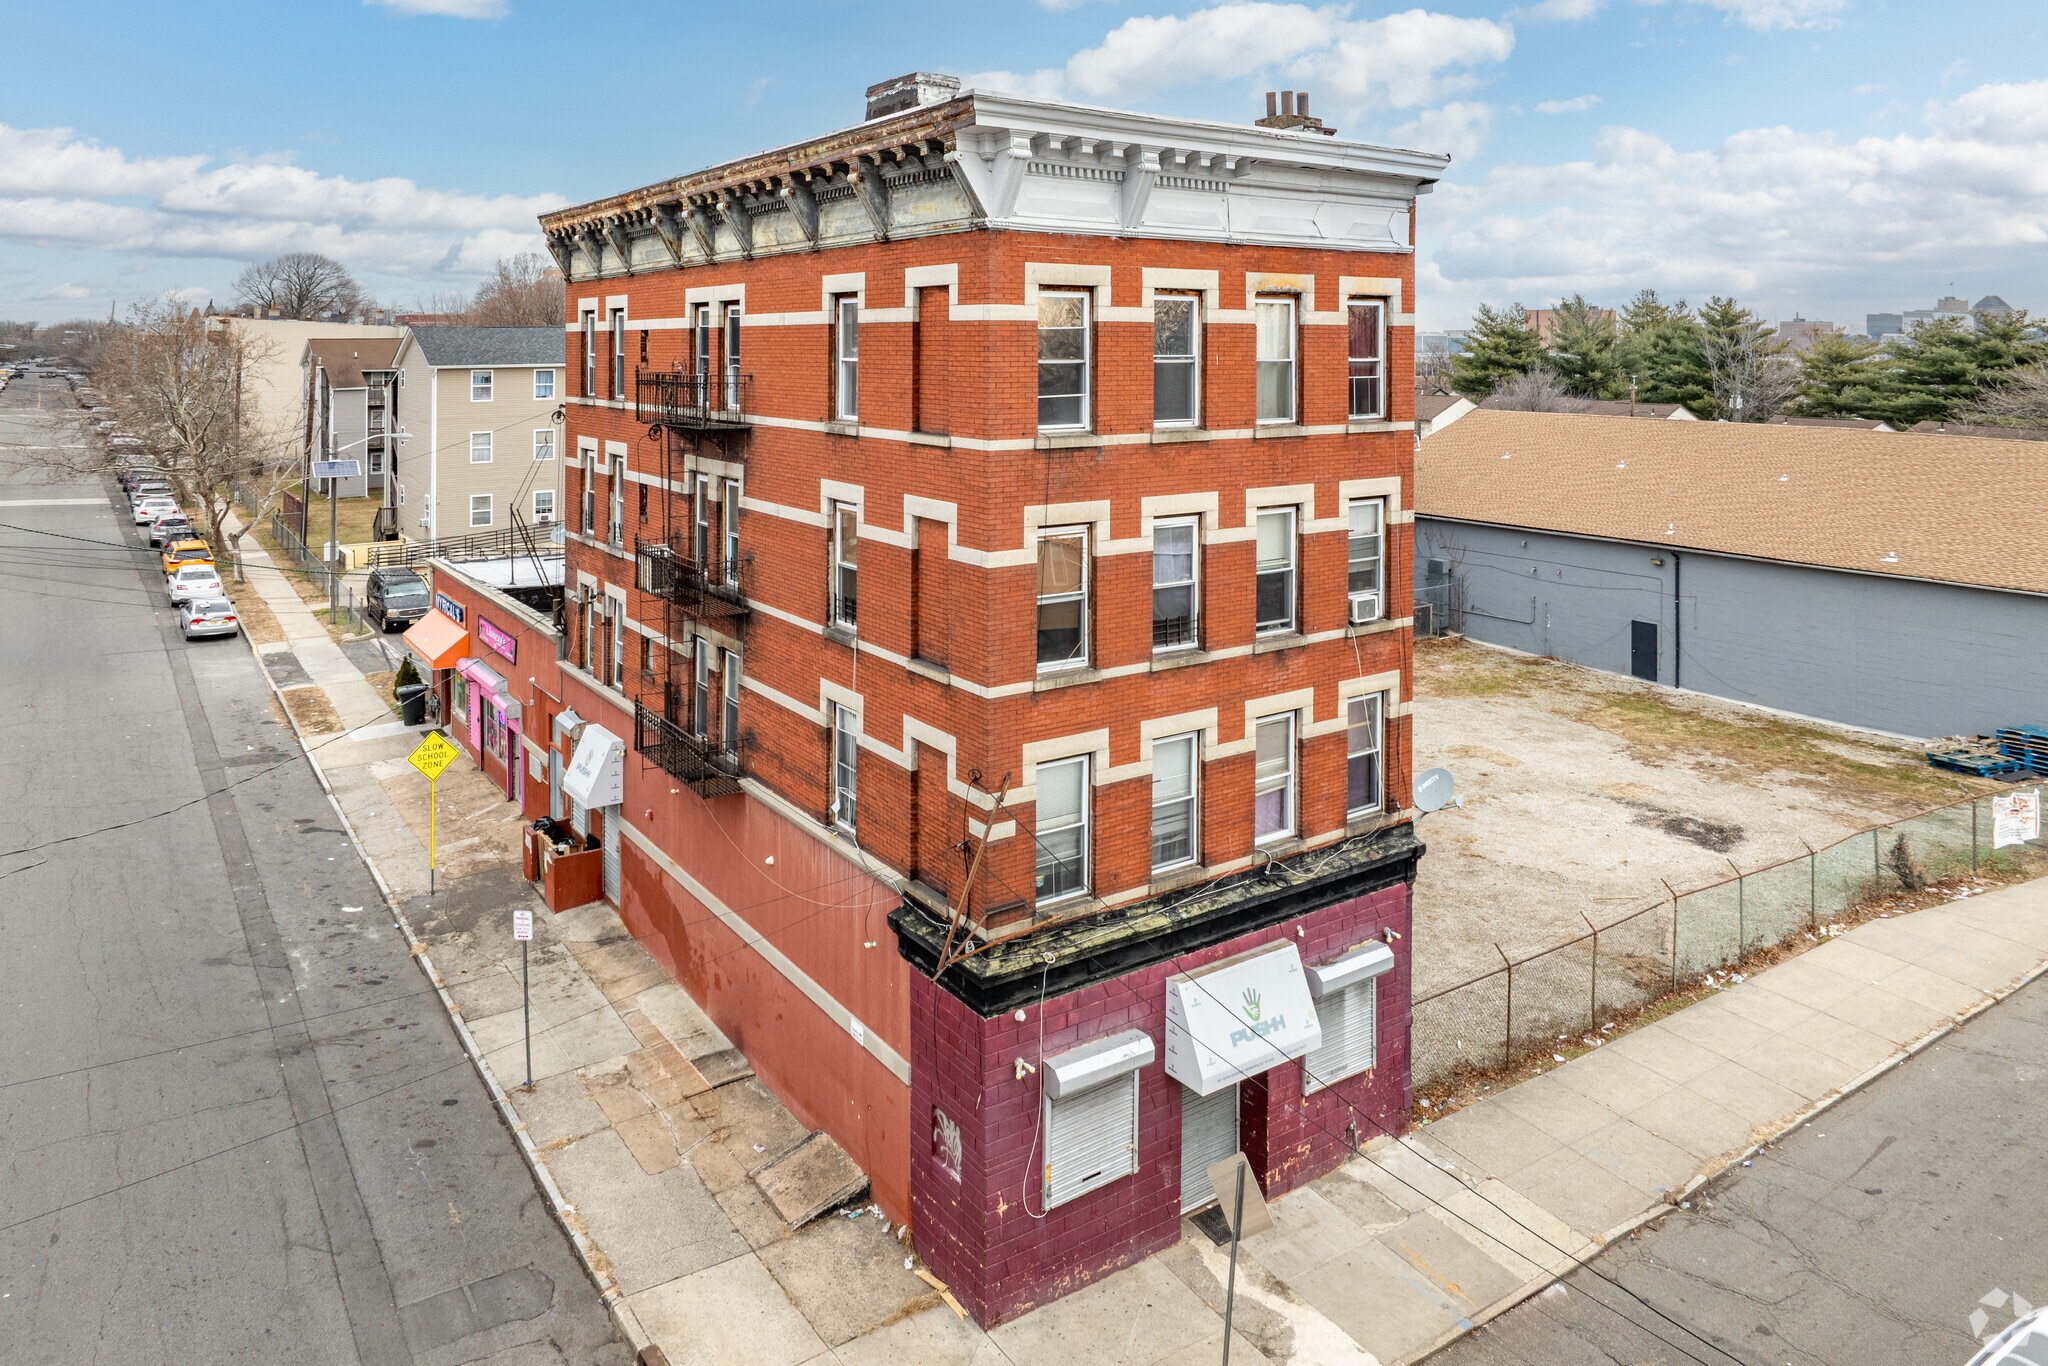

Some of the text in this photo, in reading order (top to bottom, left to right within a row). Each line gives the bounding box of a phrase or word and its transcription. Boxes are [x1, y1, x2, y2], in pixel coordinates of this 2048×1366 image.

[422, 743, 444, 752] SLOW
[417, 751, 449, 762] SCHOOL
[422, 760, 444, 770] ZONE
[1229, 1013, 1287, 1048] PUSHH
